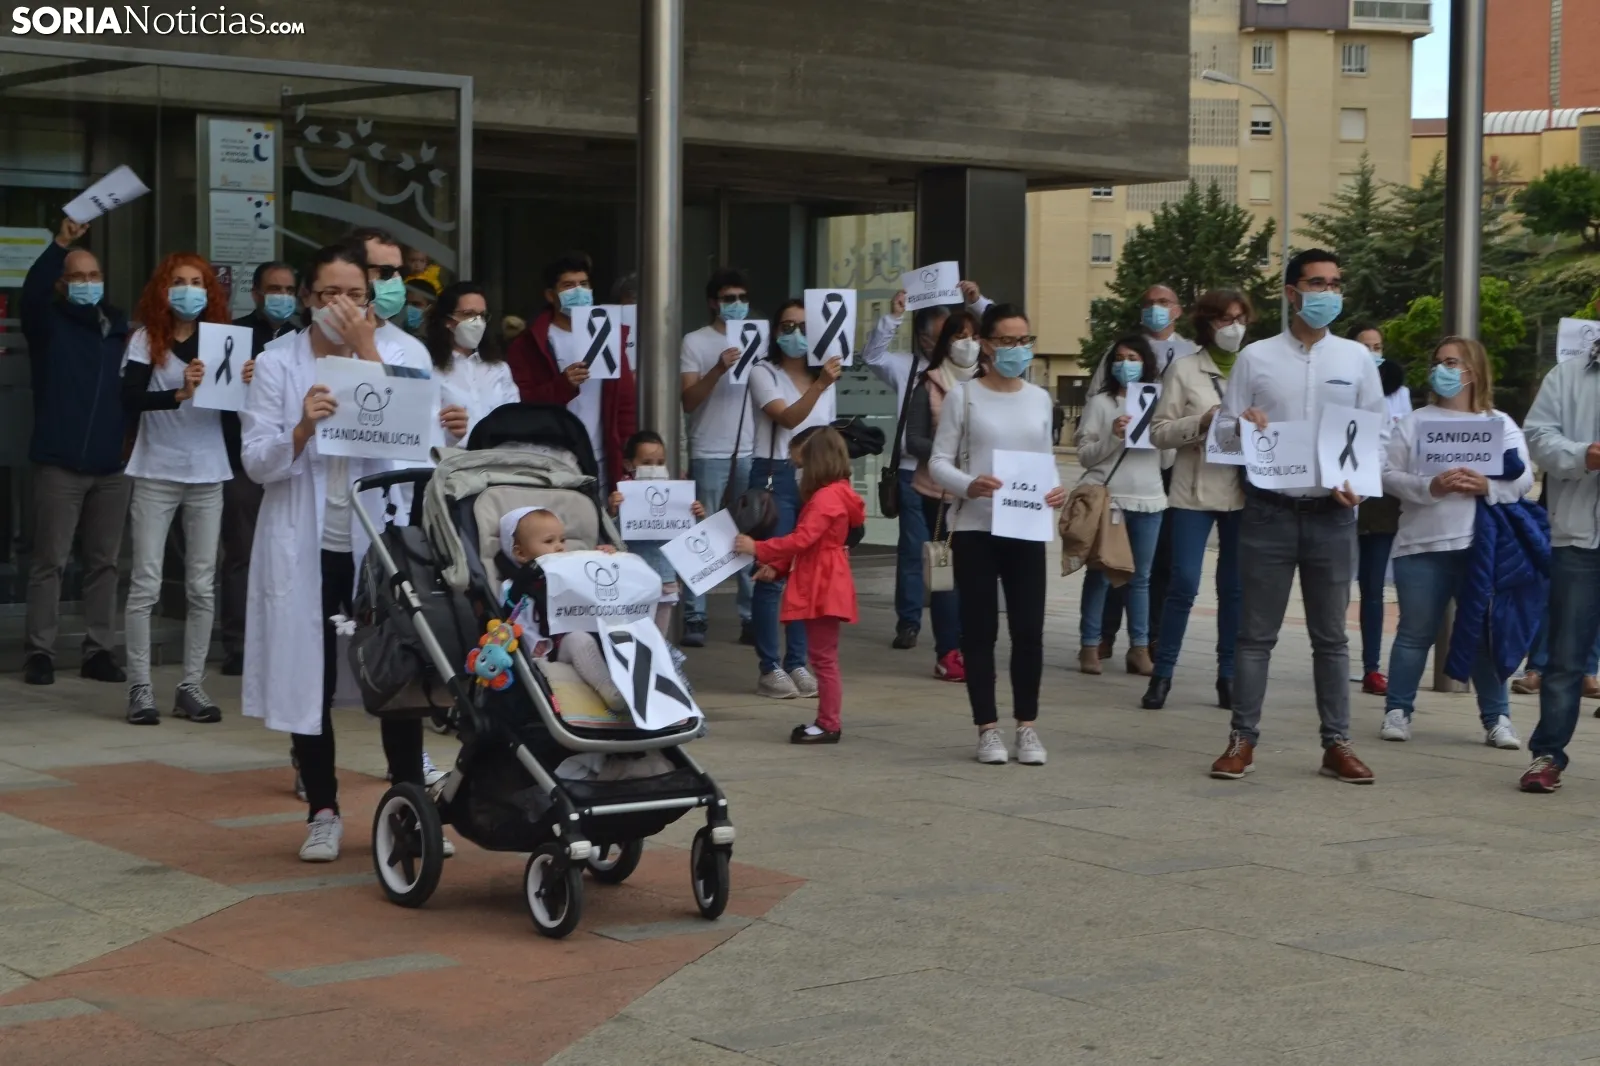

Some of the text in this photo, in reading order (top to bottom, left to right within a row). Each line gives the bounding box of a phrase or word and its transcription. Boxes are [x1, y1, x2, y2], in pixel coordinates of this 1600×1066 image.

[321, 427, 421, 446] #SANIDADENLUCHA
[1426, 432, 1492, 443] SANIDAD
[1426, 452, 1492, 463] PRIORIDAD
[625, 519, 692, 530] #BATASBLANCAS
[555, 604, 651, 618] #MEDICOSDICENBASTA
